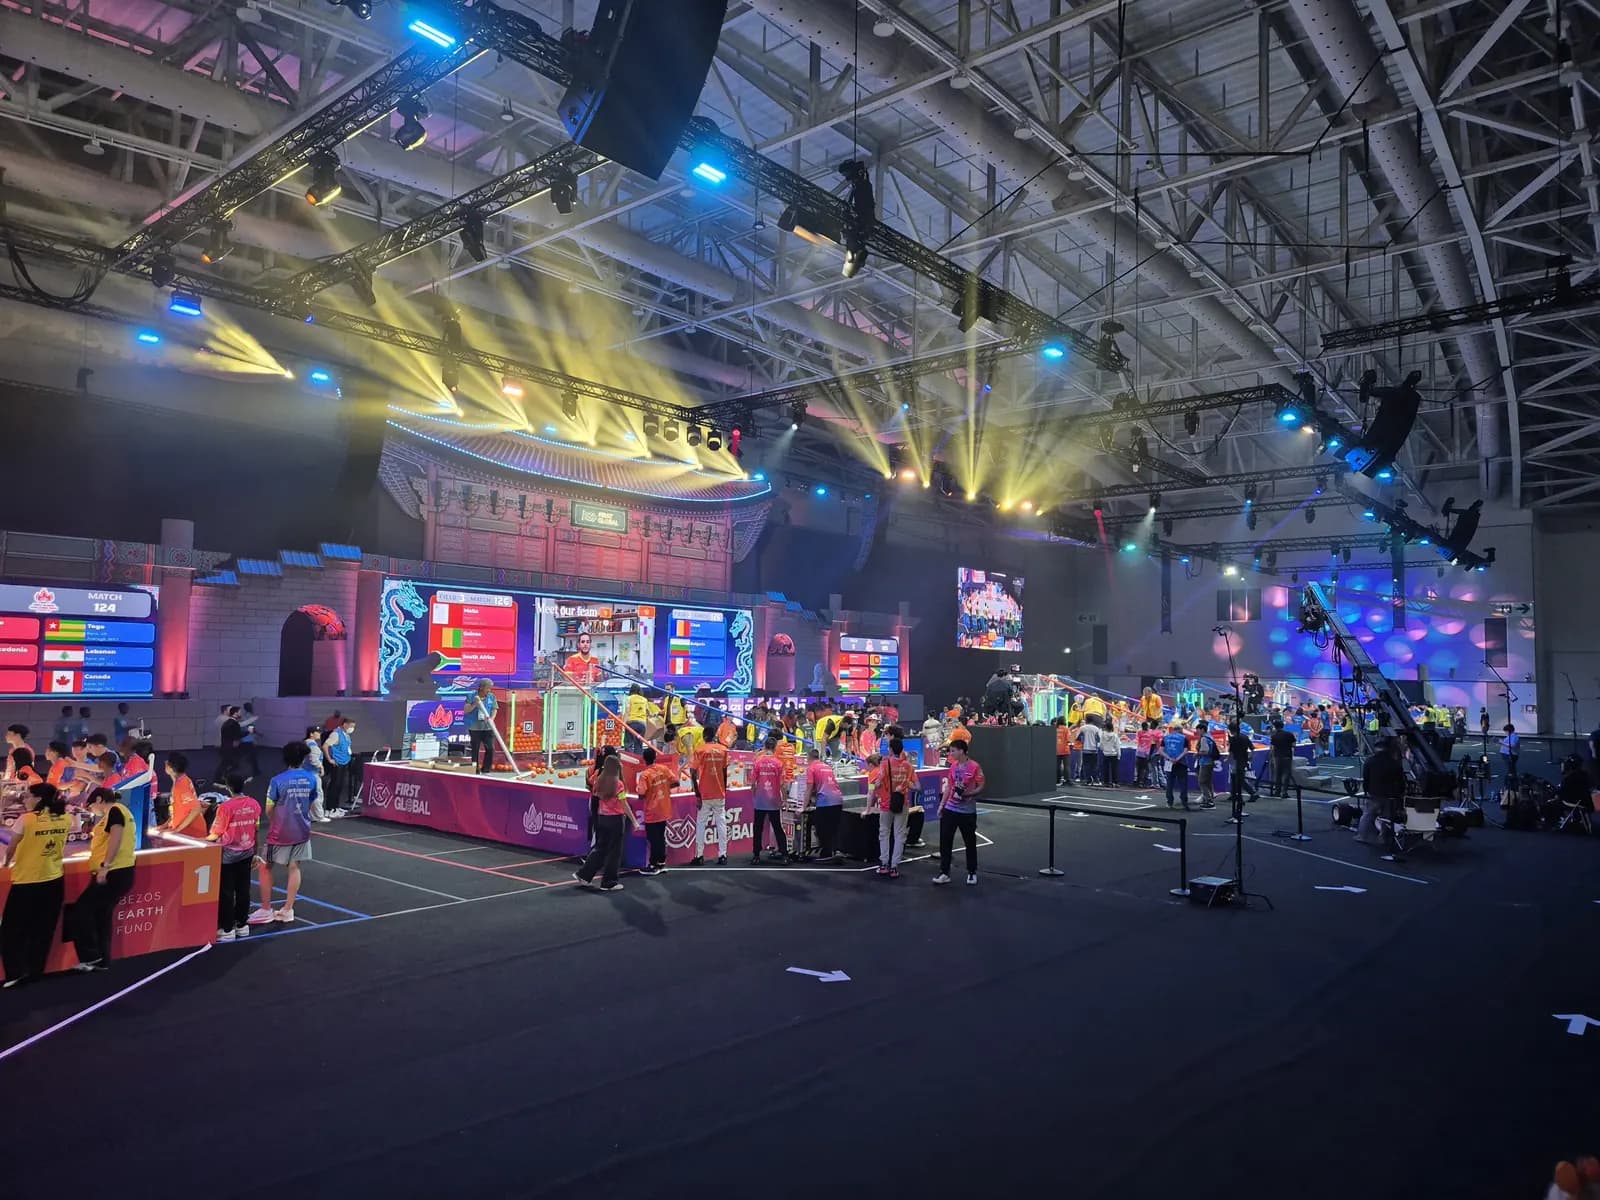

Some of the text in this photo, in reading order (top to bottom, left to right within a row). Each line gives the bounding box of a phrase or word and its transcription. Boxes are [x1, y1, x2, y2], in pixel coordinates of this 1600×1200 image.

[88, 592, 122, 600] MATCH
[94, 603, 116, 613] 124
[560, 605, 576, 617] Our
[395, 782, 421, 798] FIRST
[394, 796, 431, 815] GLOBAL
[705, 808, 743, 827] FIST
[194, 864, 211, 894] 1
[118, 891, 161, 905] BEZOS
[117, 905, 164, 920] EARTH
[115, 921, 153, 935] FUND
